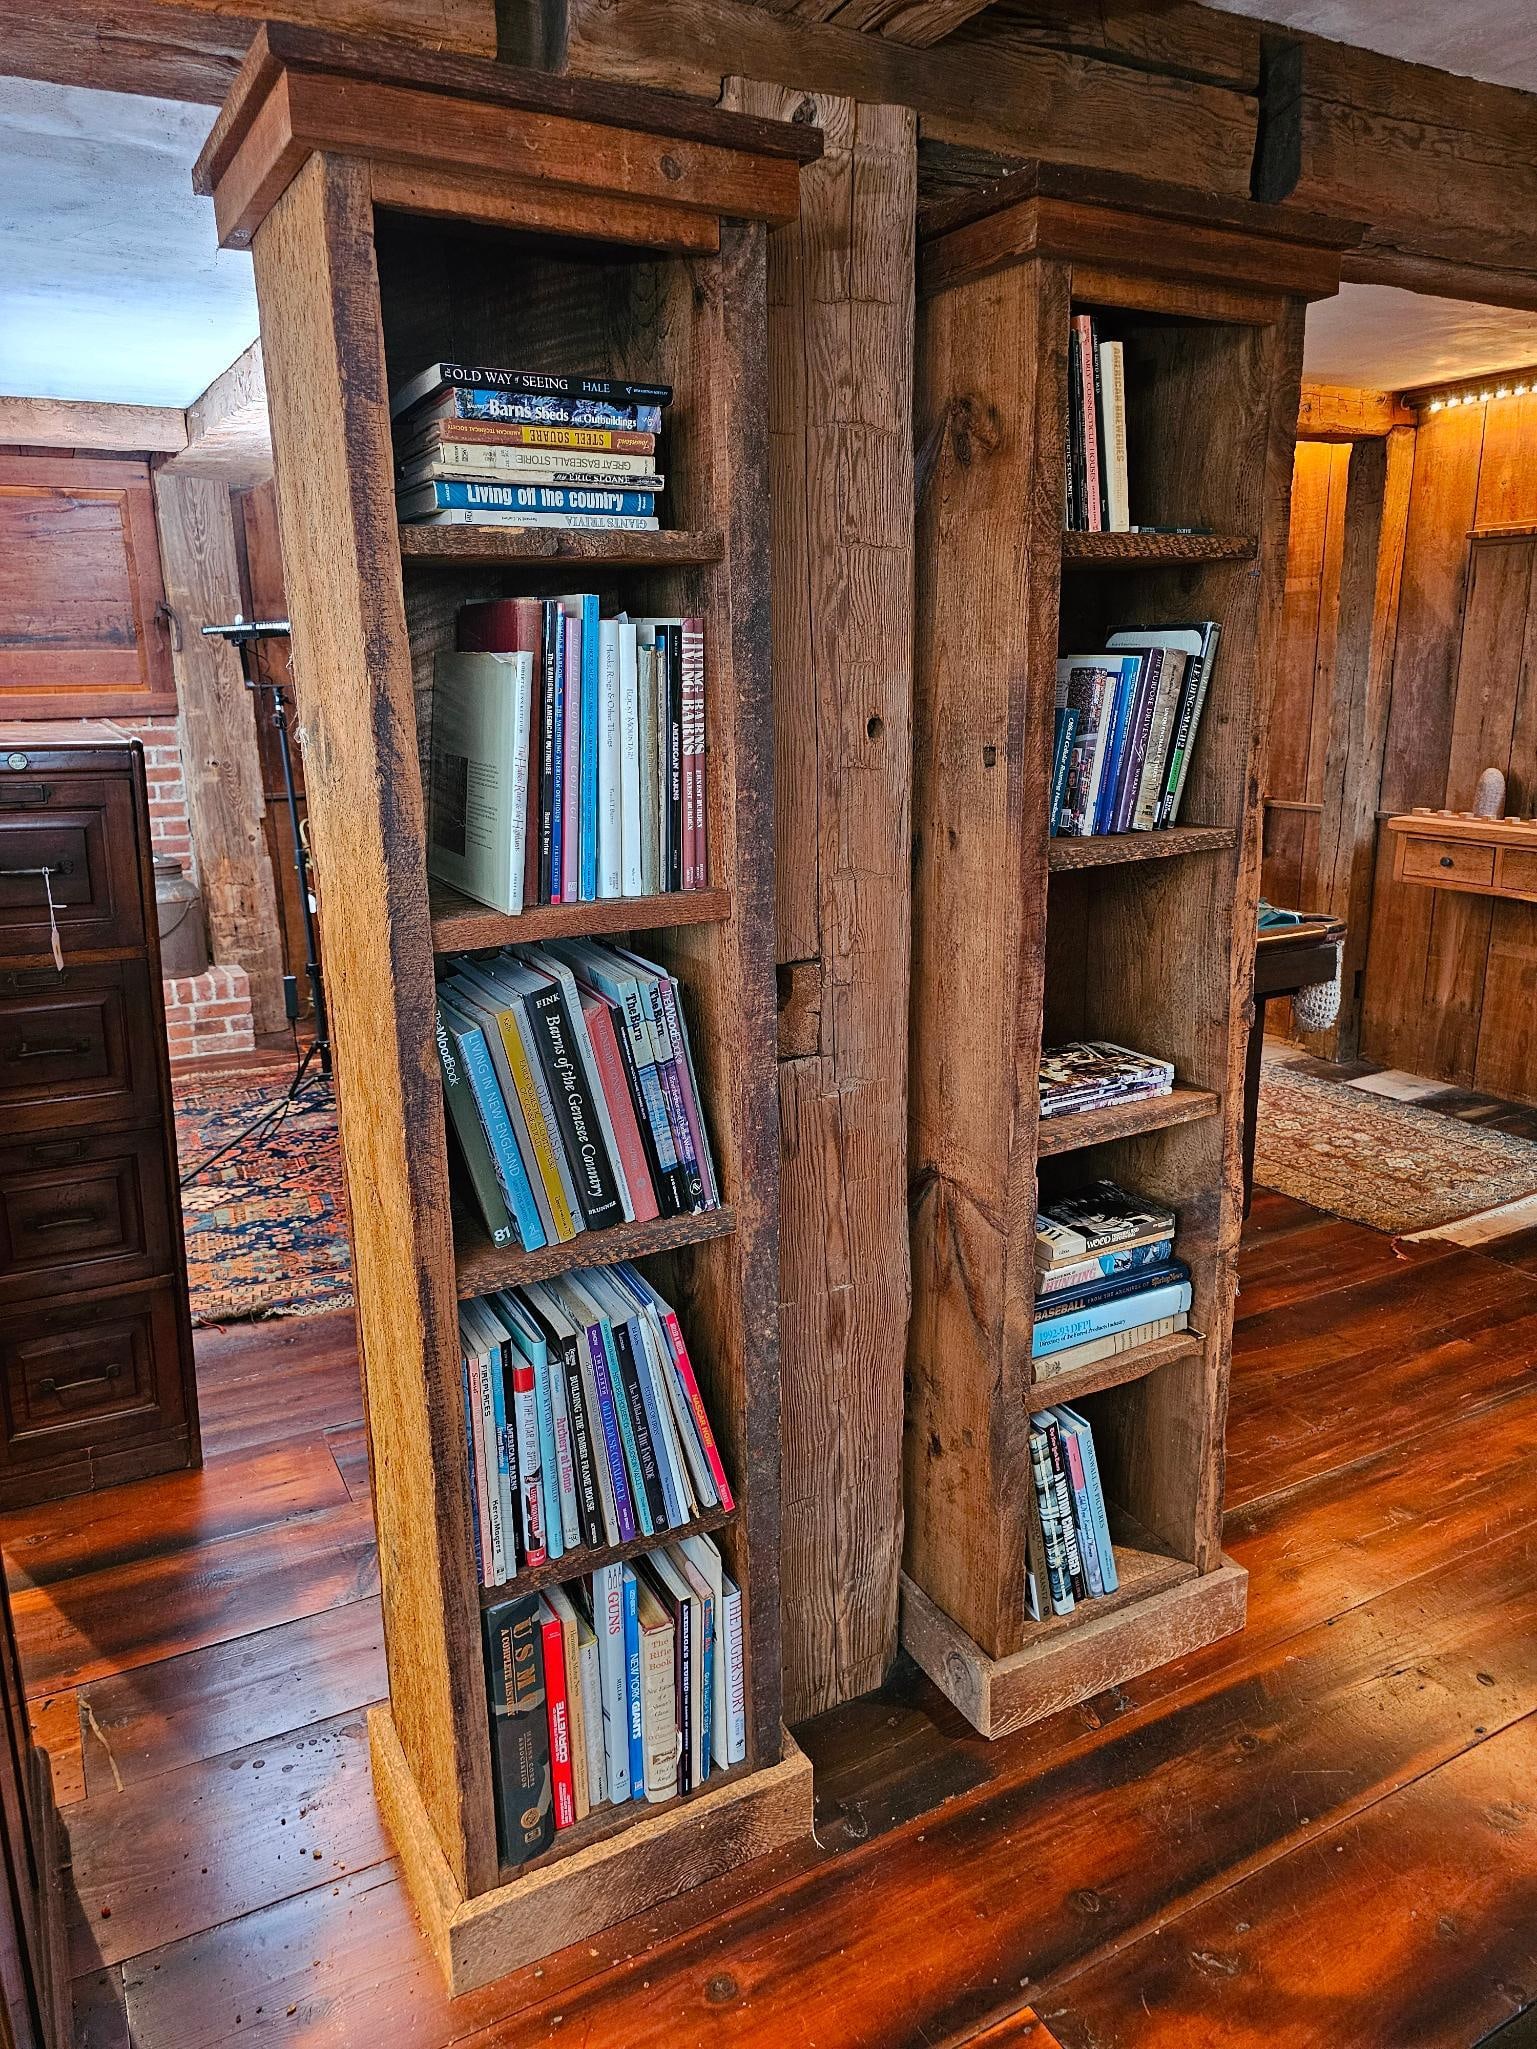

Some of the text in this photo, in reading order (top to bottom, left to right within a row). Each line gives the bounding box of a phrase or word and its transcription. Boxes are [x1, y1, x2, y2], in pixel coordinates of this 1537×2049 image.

[453, 369, 481, 381] OLD
[485, 372, 512, 384] WAY
[523, 376, 568, 390] SEEING
[583, 382, 610, 392] HALE
[490, 399, 636, 429] Barns Sheds Outbuildings
[1086, 382, 1095, 444] CONNECTICUT
[1113, 347, 1124, 462] AMERICAN BREWERIES
[529, 430, 603, 445] STEEL SQUARE
[617, 438, 649, 449] Townsend
[552, 457, 630, 470] GREAT BASEBALL
[570, 474, 630, 484] ERIC SLOANE
[467, 485, 511, 505] Living
[518, 488, 536, 505] off
[541, 489, 564, 507] the
[569, 491, 623, 511] country
[565, 516, 647, 529] GIANTS TRIVIA
[682, 632, 695, 755] LIVING BARNS
[694, 632, 704, 754] LIVING BARNS
[1147, 670, 1160, 705] PURPOSE
[1179, 663, 1201, 740] LEADING MACH
[1192, 675, 1209, 728] NEW WORLD
[570, 702, 578, 758] COUNTRY
[606, 722, 614, 748] Things
[1141, 708, 1153, 738] DRIVEN
[1050, 741, 1072, 824] Cellular Roaming Handbook
[1131, 768, 1141, 795] WARREN
[535, 993, 561, 1009] FINK
[626, 993, 637, 1012] The
[649, 988, 664, 1037] The Barn
[627, 1011, 642, 1041] Barn
[469, 1035, 520, 1176] LIVING IN NEW ENGLAND
[520, 1059, 540, 1117] EARLY DOMESTIC
[546, 1014, 602, 1197] Barns of the Genesee Country
[535, 1084, 562, 1160] OLD HOUSES
[493, 1228, 512, 1242] 81
[1087, 1235, 1111, 1248] WOOD
[1045, 1269, 1097, 1292] HUNTING
[1034, 1299, 1086, 1322] BASEBALL
[1088, 1295, 1102, 1303] FROM
[1115, 1285, 1141, 1295] ARCHIVES
[618, 1332, 626, 1351] Larson
[1039, 1320, 1091, 1342] 1992-93 DFPI
[1039, 1337, 1060, 1347] Directory
[1088, 1324, 1107, 1335] Products
[481, 1365, 491, 1416] FIREPLACES
[540, 1366, 552, 1437] PERIOD KITCHENS
[523, 1395, 537, 1470] AT THE ALTAR OF SPEED
[692, 1394, 713, 1448] NASCAR NOW!
[507, 1423, 517, 1490] AMERICAN BARNS
[556, 1416, 572, 1493] Archery at Home
[569, 1375, 595, 1512] BUILDING THE TIMBER FRAME HOUSE
[602, 1401, 626, 1502] OLD HOUSE CATALOGUE
[623, 1431, 642, 1491] THE VALLEY
[638, 1430, 651, 1464] THE FAR
[1086, 1440, 1105, 1528] CORNWALL IN PICTURES
[1054, 1472, 1080, 1575] A NATION CHALLENGED
[1083, 1519, 1091, 1540] England
[608, 1592, 620, 1635] GUNS
[502, 1637, 513, 1680] COMPLETE
[649, 1659, 672, 1670] Book
[650, 1649, 671, 1659] Rifle
[652, 1640, 668, 1648] The
[730, 1598, 744, 1715] THE LUGER STORY
[505, 1682, 515, 1717] HISTORY
[630, 1653, 641, 1739] NEW YORK GIANTS
[557, 1701, 568, 1763] CORVETTE
[518, 1737, 526, 1788] ASSOCIATION
